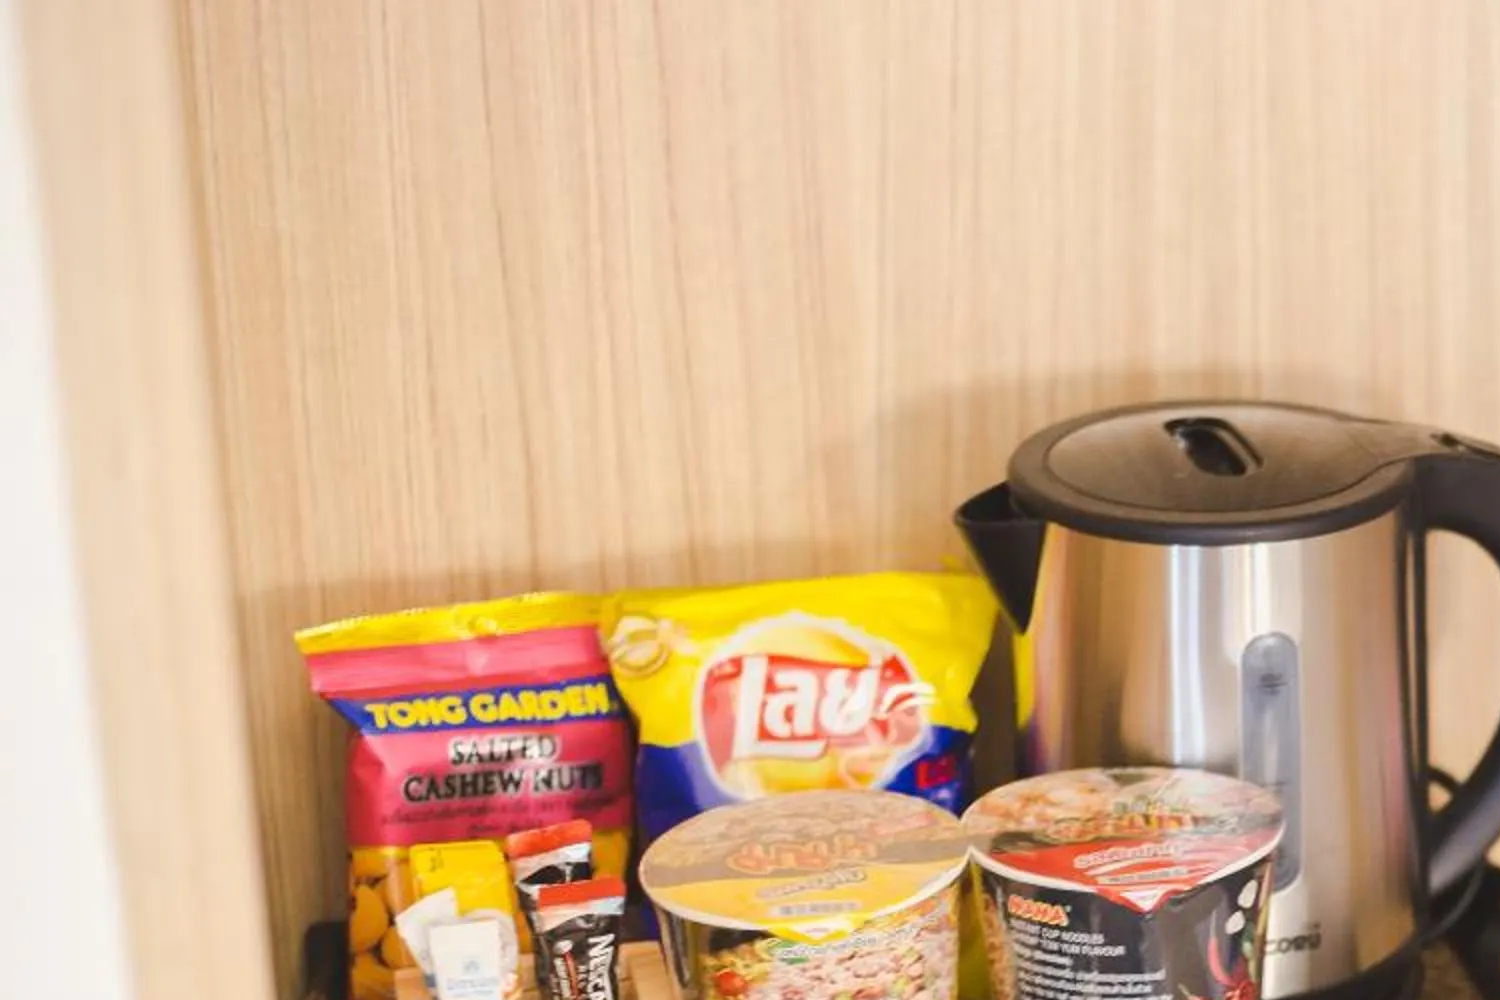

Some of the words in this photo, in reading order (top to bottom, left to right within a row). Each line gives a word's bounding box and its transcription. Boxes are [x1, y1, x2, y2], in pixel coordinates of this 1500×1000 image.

[366, 695, 467, 729] TONG
[470, 683, 611, 723] GARDEN
[450, 735, 559, 766] SALTED
[403, 768, 524, 803] CASHEW
[532, 763, 604, 793] NUTS
